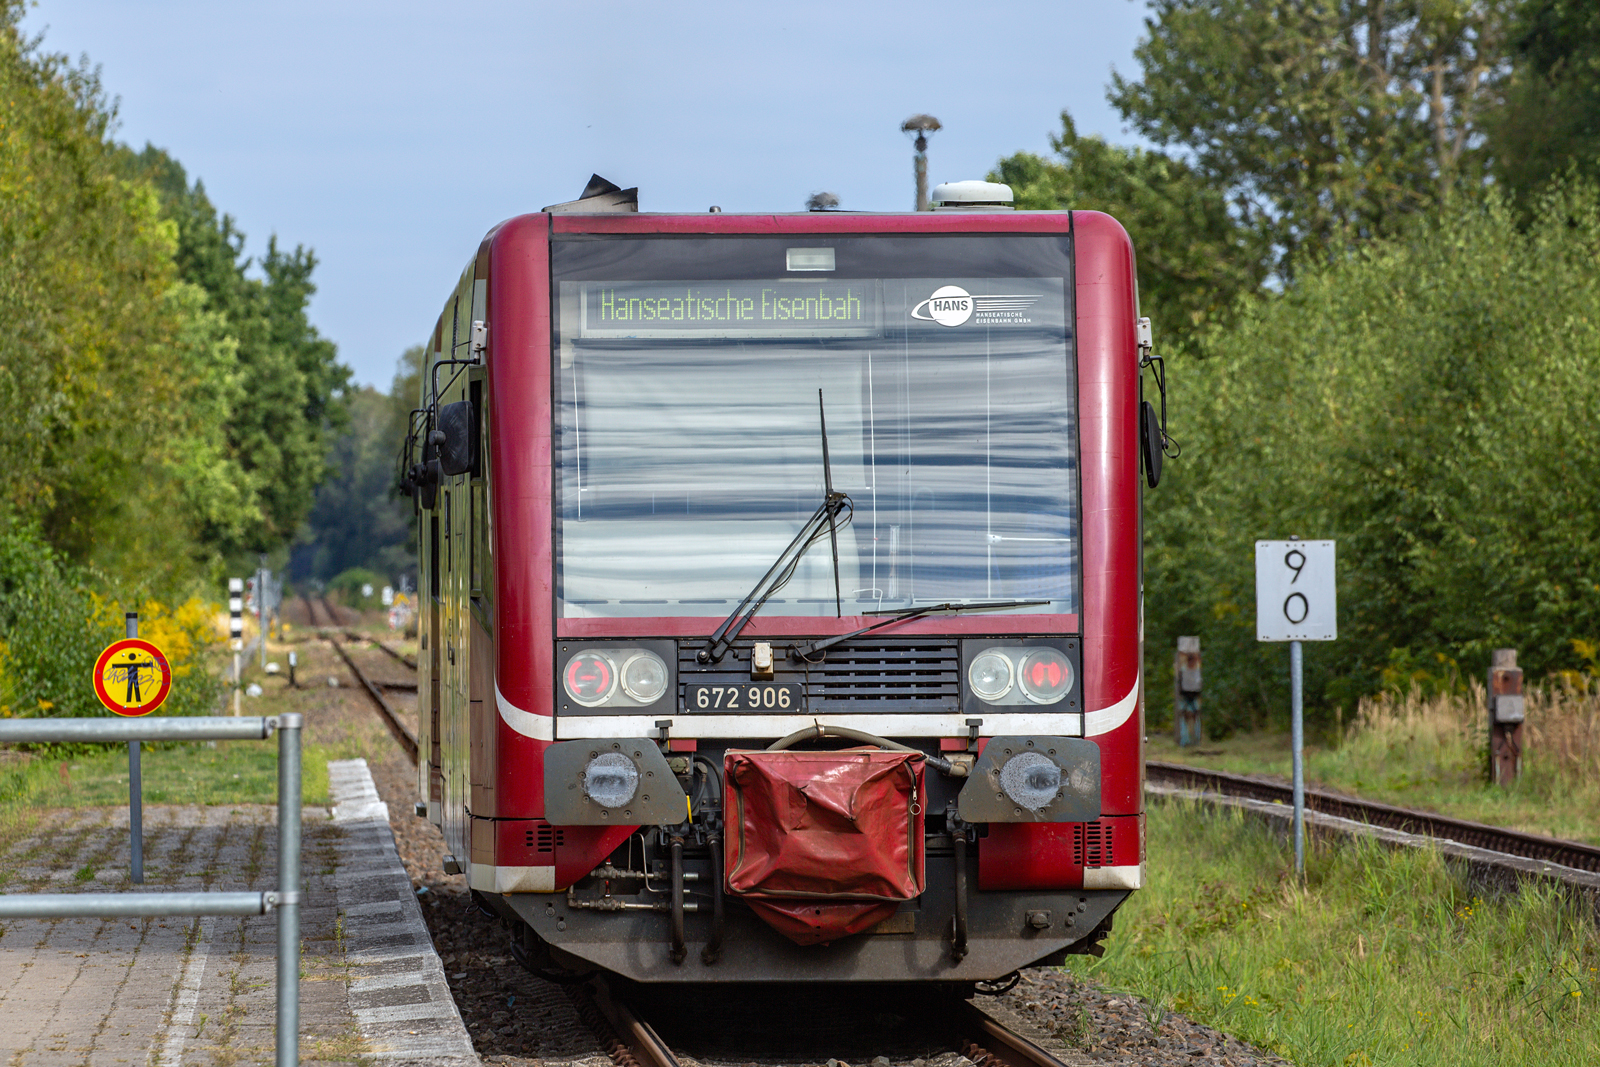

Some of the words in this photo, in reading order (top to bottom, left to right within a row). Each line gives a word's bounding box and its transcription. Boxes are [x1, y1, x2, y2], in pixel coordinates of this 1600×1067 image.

[601, 288, 754, 320] Hanseatische
[761, 288, 861, 320] Eisenbah
[933, 300, 969, 312] HANS
[1284, 549, 1307, 585] 9
[1283, 592, 1309, 625] 0
[696, 686, 740, 709] 672
[748, 686, 791, 709] 906
